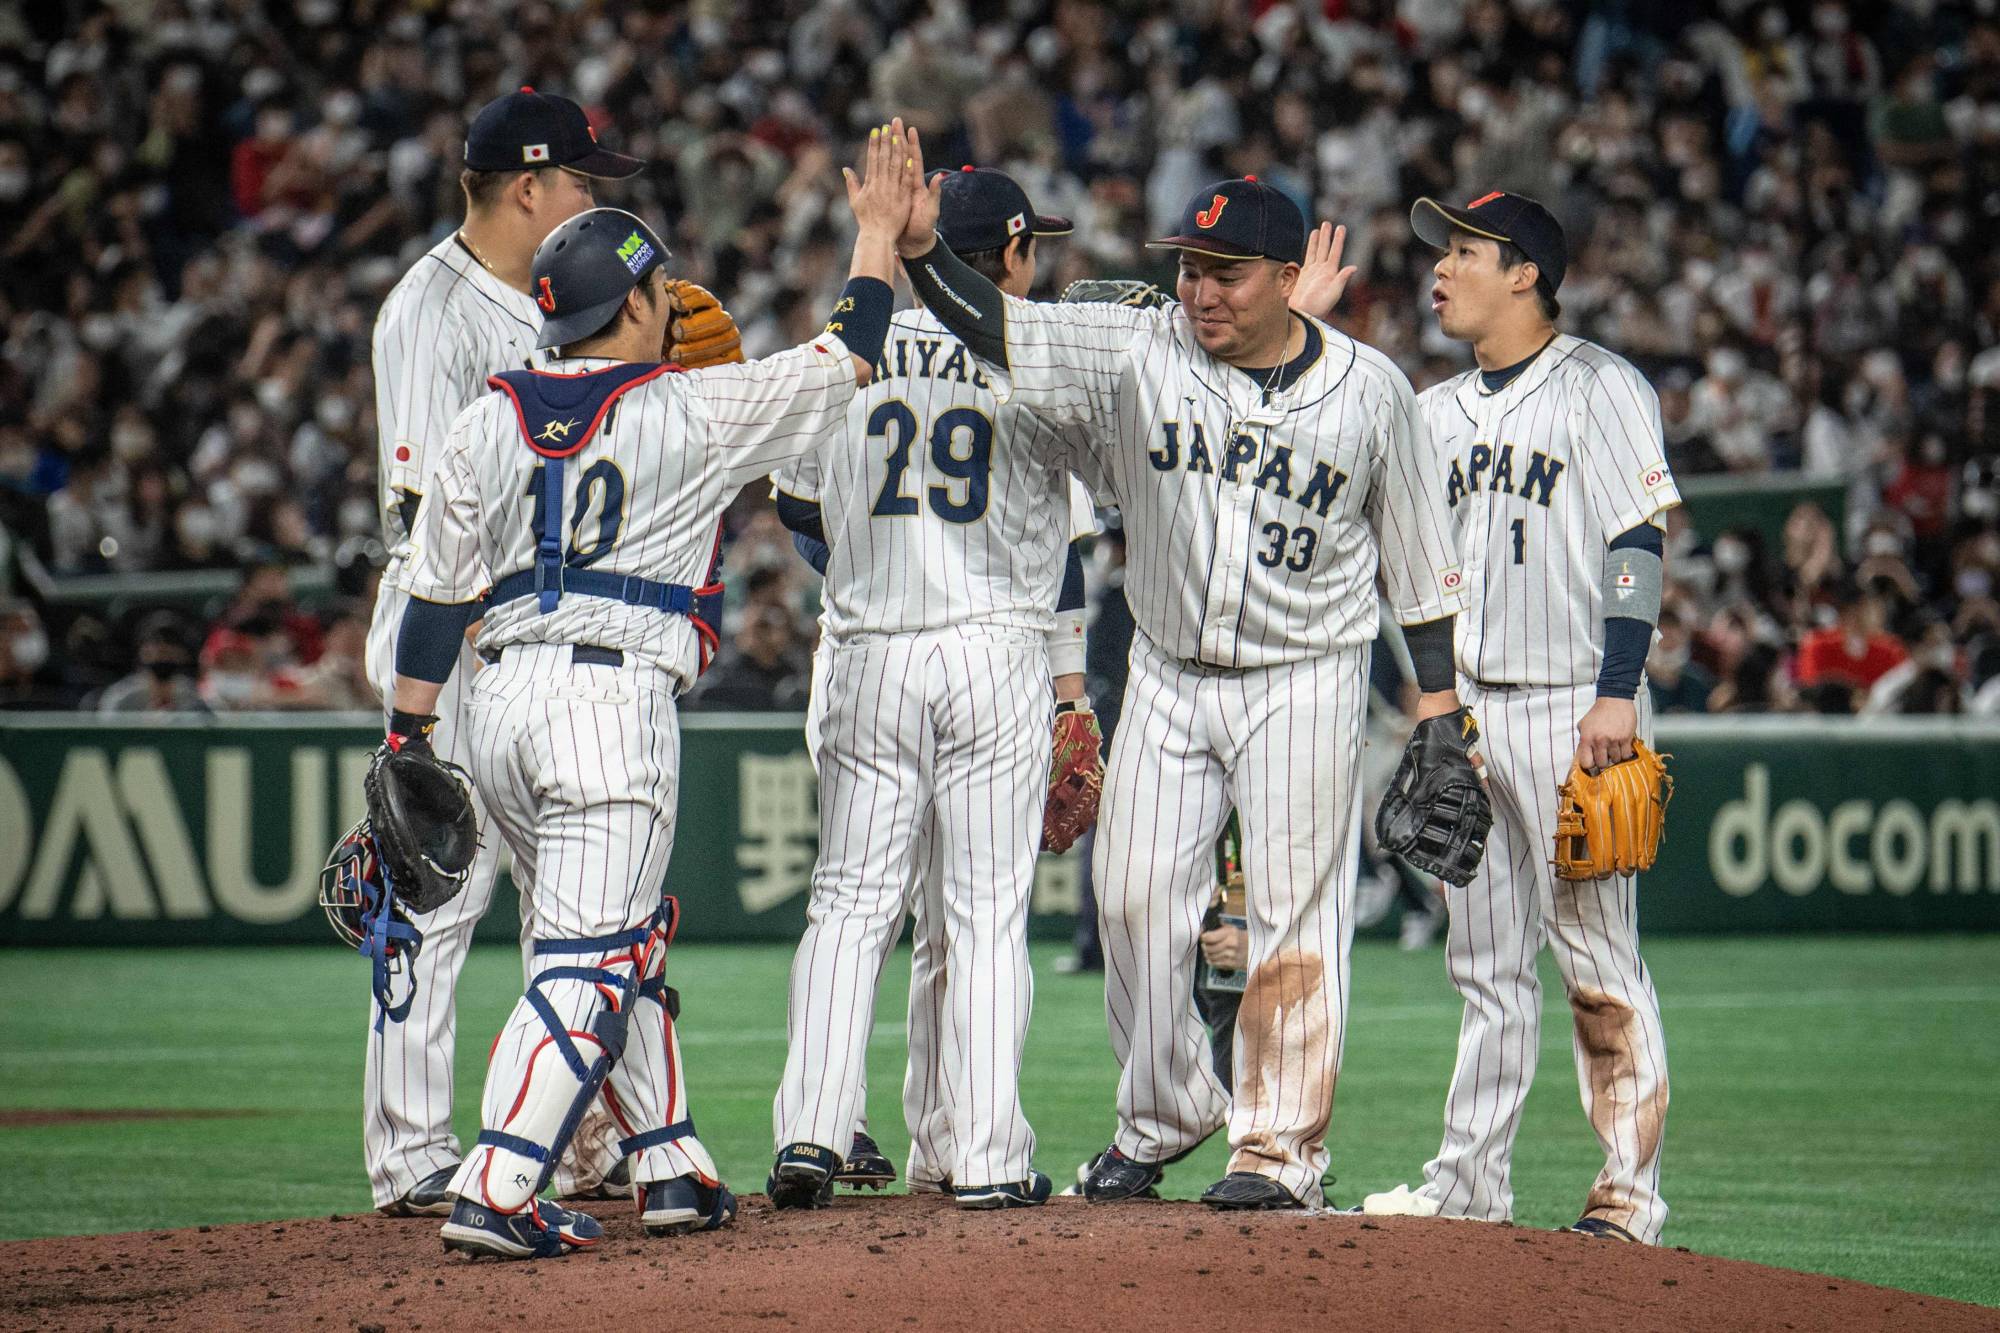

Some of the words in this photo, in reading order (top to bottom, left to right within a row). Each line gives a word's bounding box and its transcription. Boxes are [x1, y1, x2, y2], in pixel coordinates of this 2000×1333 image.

[1196, 194, 1229, 229] J
[616, 231, 645, 262] NX
[626, 241, 650, 269] NIPPON
[630, 247, 655, 276] EXPRESS
[537, 276, 556, 312] J
[866, 396, 994, 526] 29
[1148, 419, 1349, 520] JAPAN
[1447, 440, 1566, 509] APAN
[1256, 520, 1319, 573] 33
[1509, 516, 1527, 565] 1
[1708, 761, 2000, 898] docom
[793, 1145, 820, 1159] JAPAN
[468, 1212, 486, 1227] 10
